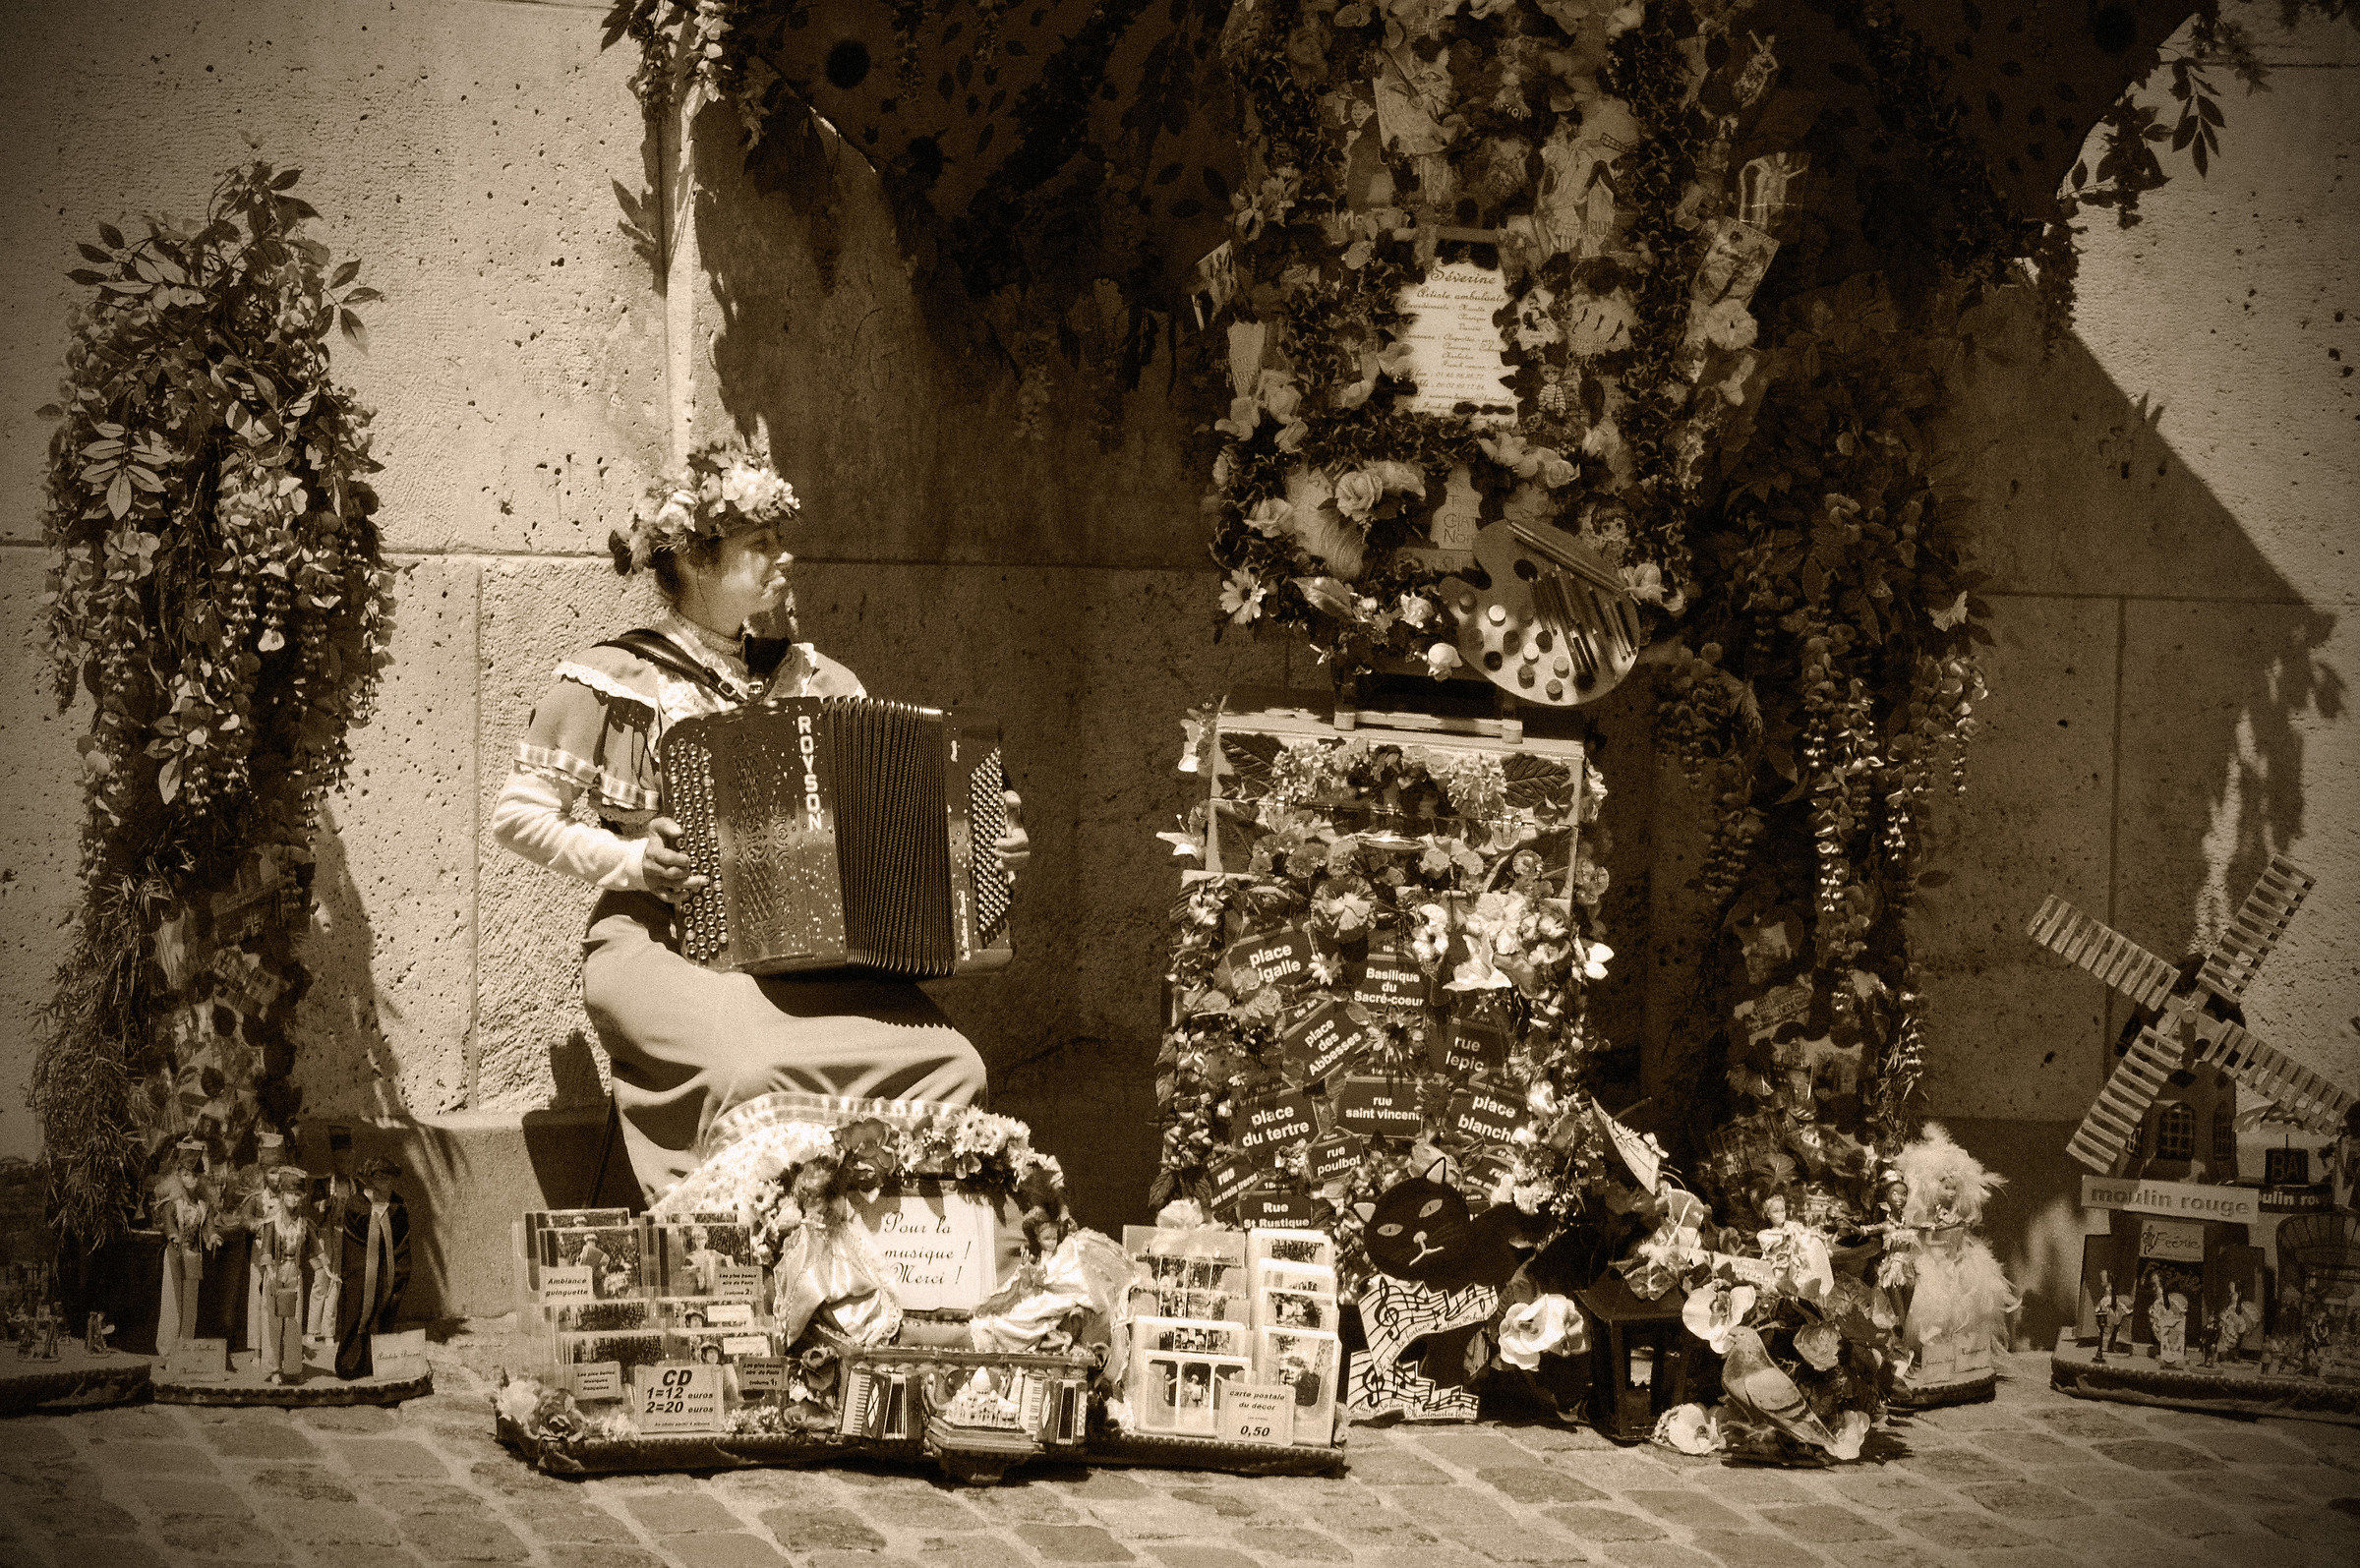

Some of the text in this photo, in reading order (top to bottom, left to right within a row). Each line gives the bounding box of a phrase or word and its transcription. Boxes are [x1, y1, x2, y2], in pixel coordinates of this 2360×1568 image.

[1430, 265, 1497, 285] Séverine
[797, 715, 823, 832] ROYSON
[1249, 945, 1293, 969] place
[1259, 959, 1302, 983] igalle
[1365, 966, 1421, 984] Basilique
[1382, 981, 1397, 993] du
[1353, 990, 1425, 1007] Sacré-coeur
[1304, 1018, 1334, 1048] place
[1318, 1032, 1339, 1052] des
[1453, 1035, 1481, 1052] rue
[1309, 1032, 1362, 1076] Abbesses
[1445, 1050, 1485, 1073] lepic
[1373, 1096, 1393, 1107] rue
[1471, 1095, 1517, 1119] place
[1251, 1106, 1295, 1130] place
[1345, 1107, 1422, 1122] saint vincent
[1242, 1132, 1264, 1148] du
[1266, 1121, 1310, 1142] tertre
[1327, 1146, 1346, 1159] rue
[1317, 1154, 1361, 1178] poulbot
[1216, 1166, 1235, 1187] rue
[1263, 1201, 1290, 1214] Rue
[2090, 1187, 2250, 1217] moulin rouge
[2262, 1190, 2295, 1207] ulin
[883, 1210, 952, 1234] Pour la
[1243, 1218, 1311, 1229] St Rustique
[884, 1240, 972, 1265] musique !
[547, 1277, 587, 1286] Ambiance
[889, 1261, 963, 1285] Merci !
[545, 1288, 589, 1298] guinguette
[662, 1368, 693, 1387] CD
[646, 1386, 684, 1400] 1=12
[1253, 1392, 1285, 1401] postale
[645, 1401, 684, 1414] 2=20
[1239, 1424, 1270, 1438] 0,50
